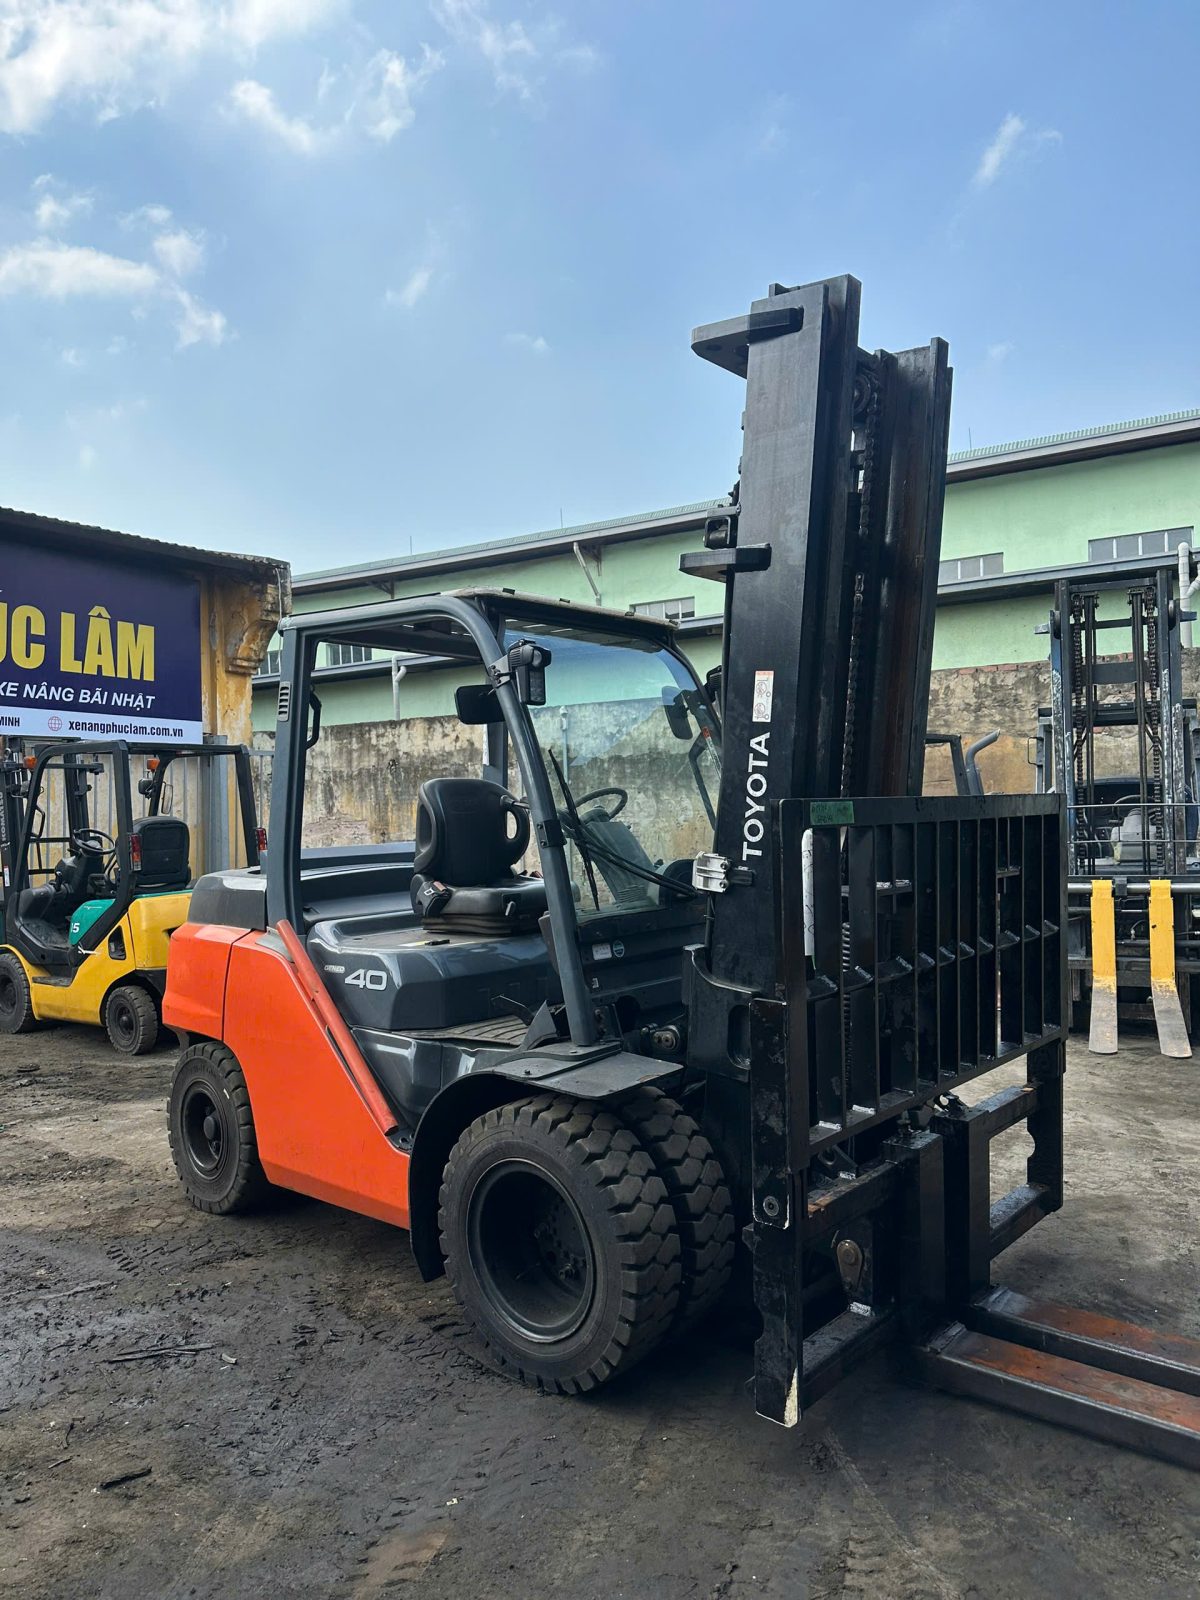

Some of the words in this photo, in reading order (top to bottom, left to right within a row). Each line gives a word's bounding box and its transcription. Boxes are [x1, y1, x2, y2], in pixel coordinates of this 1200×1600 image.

[60, 605, 155, 682] LÂM
[23, 682, 75, 702] NÂNG
[79, 688, 108, 705] BÃI
[111, 692, 156, 711] NHẬT
[68, 720, 184, 738] xenangphuclam.com.vn
[742, 732, 771, 861] TOYOTA
[344, 968, 388, 991] 40
